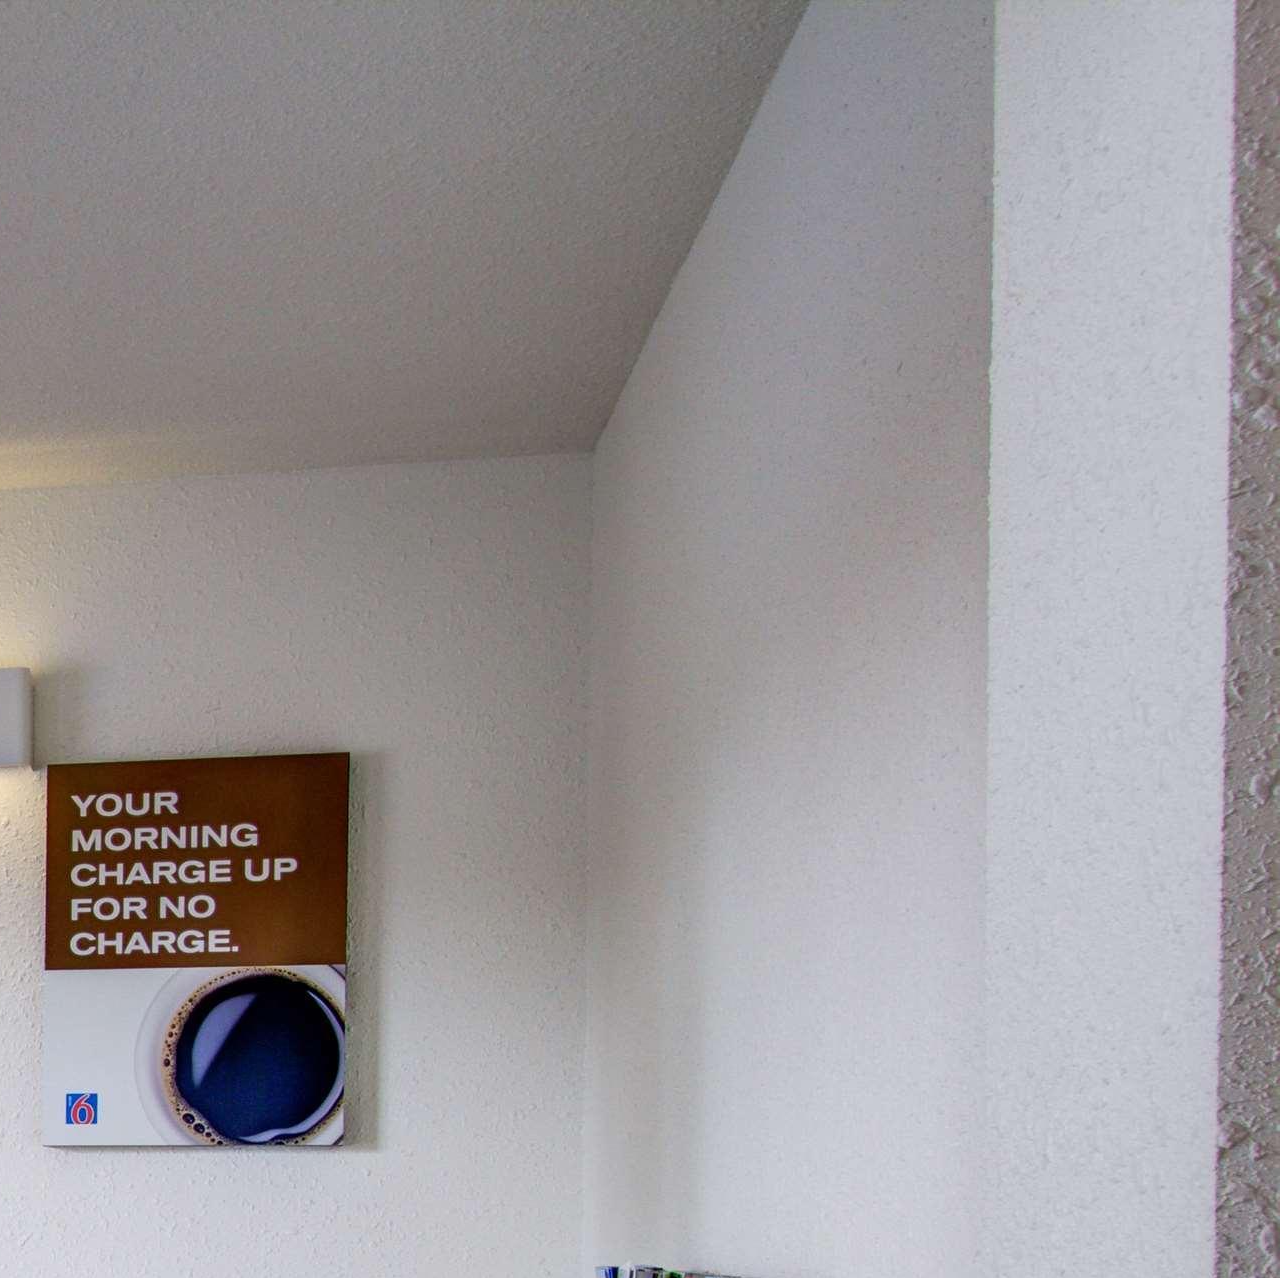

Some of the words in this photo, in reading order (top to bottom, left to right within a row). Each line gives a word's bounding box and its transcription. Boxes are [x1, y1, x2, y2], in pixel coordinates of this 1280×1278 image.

[71, 792, 179, 817] YOUR
[71, 823, 259, 852] MORNING
[70, 859, 232, 887] CHARGE
[244, 857, 298, 883] UP
[70, 896, 148, 921] FOR
[159, 894, 216, 919] NO
[69, 929, 239, 956] CHARGE.
[71, 1094, 94, 1126] 6
